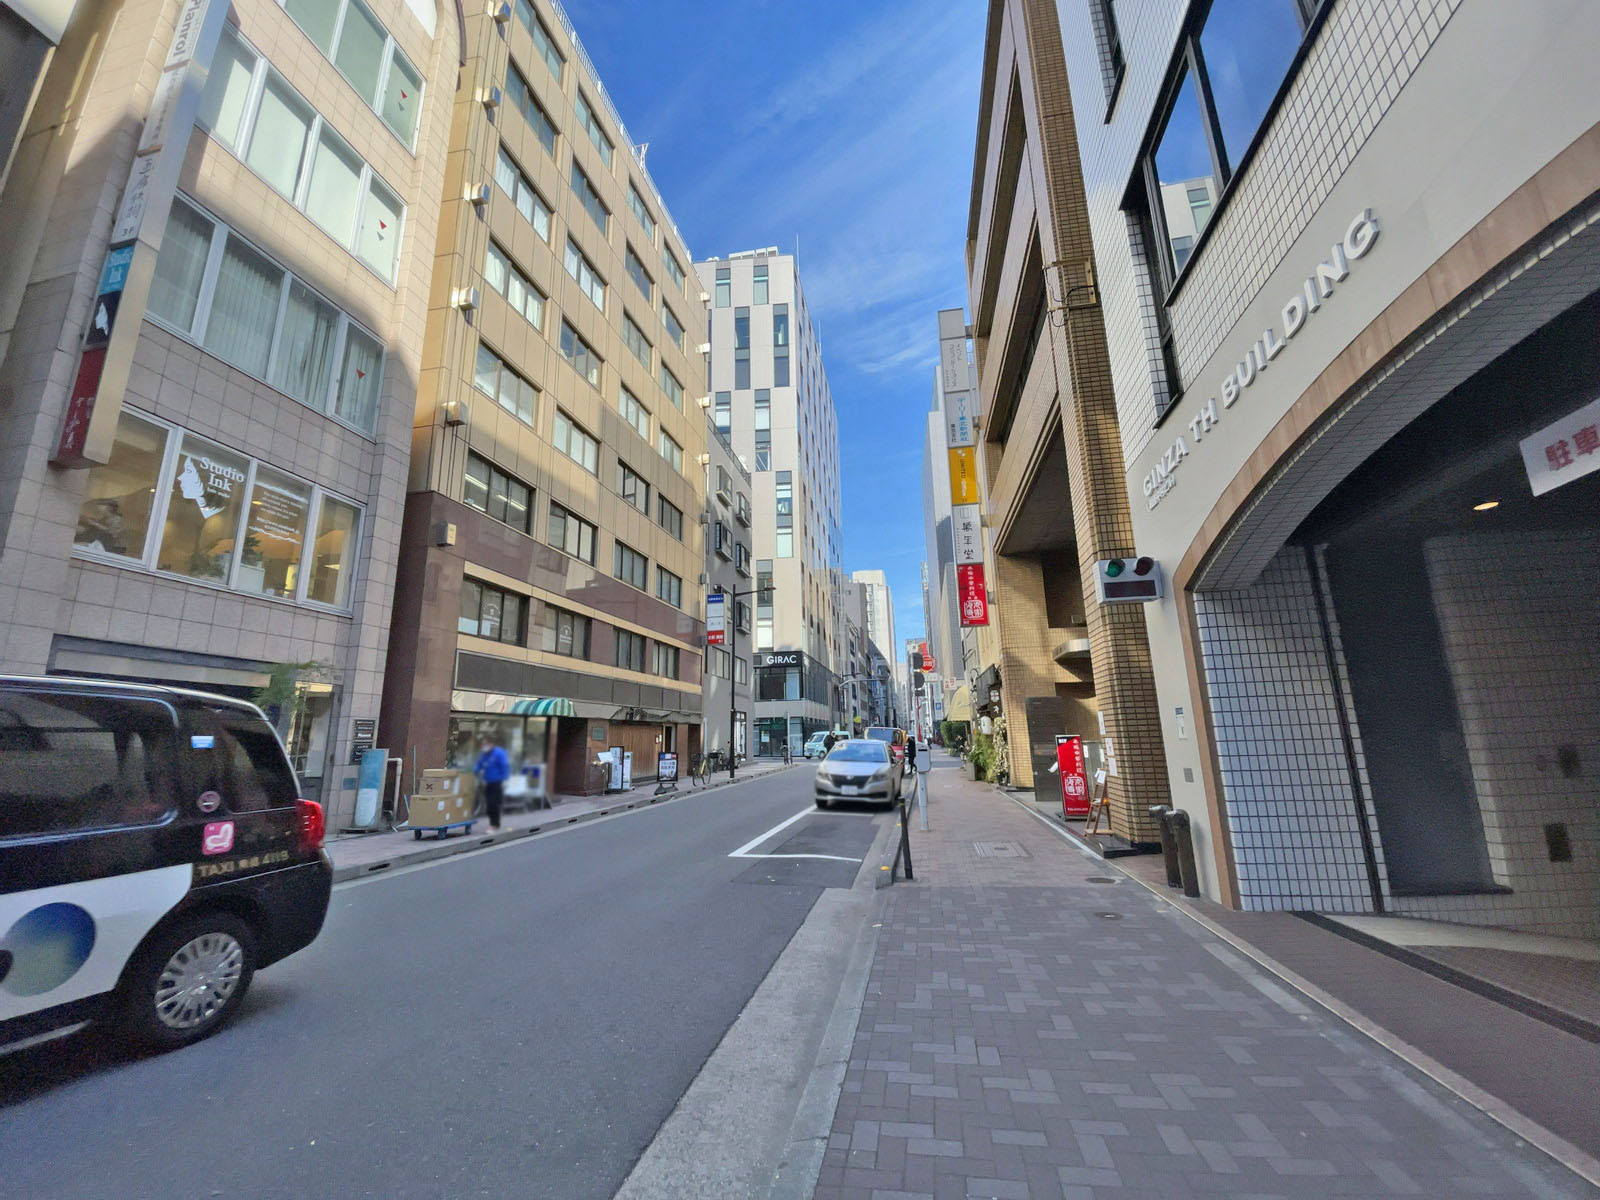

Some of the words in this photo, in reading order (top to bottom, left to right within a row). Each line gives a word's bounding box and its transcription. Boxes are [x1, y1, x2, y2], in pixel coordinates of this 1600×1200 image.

[1143, 436, 1189, 496] GINZA
[1189, 397, 1218, 443] TH
[1221, 208, 1380, 410] BUILDING
[200, 457, 244, 482] Studio
[208, 472, 233, 491] Ink
[199, 861, 235, 877] TAXI
